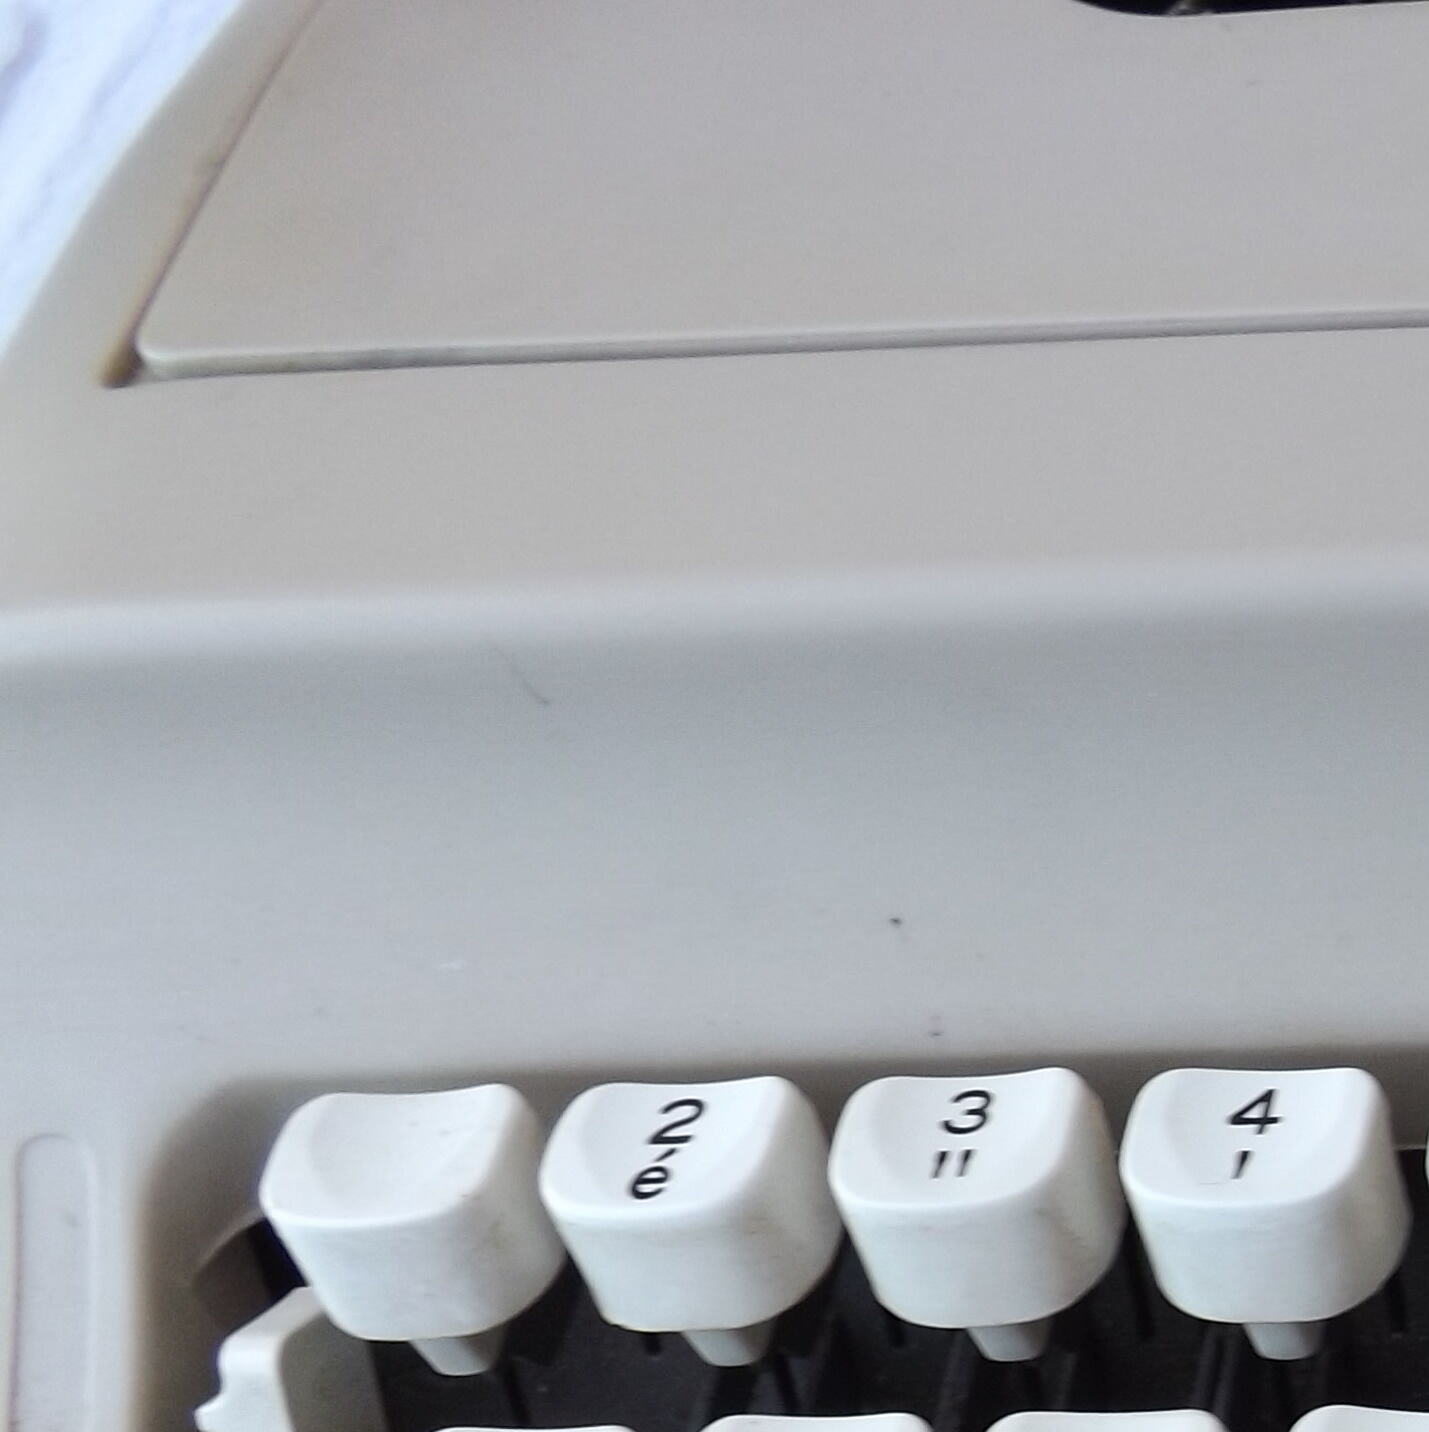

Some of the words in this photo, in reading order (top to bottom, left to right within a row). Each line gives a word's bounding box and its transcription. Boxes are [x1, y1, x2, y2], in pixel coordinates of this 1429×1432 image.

[647, 1097, 706, 1146] 2
[941, 1088, 993, 1136] 3
[1227, 1087, 1281, 1136] 4
[628, 1147, 675, 1201] é
